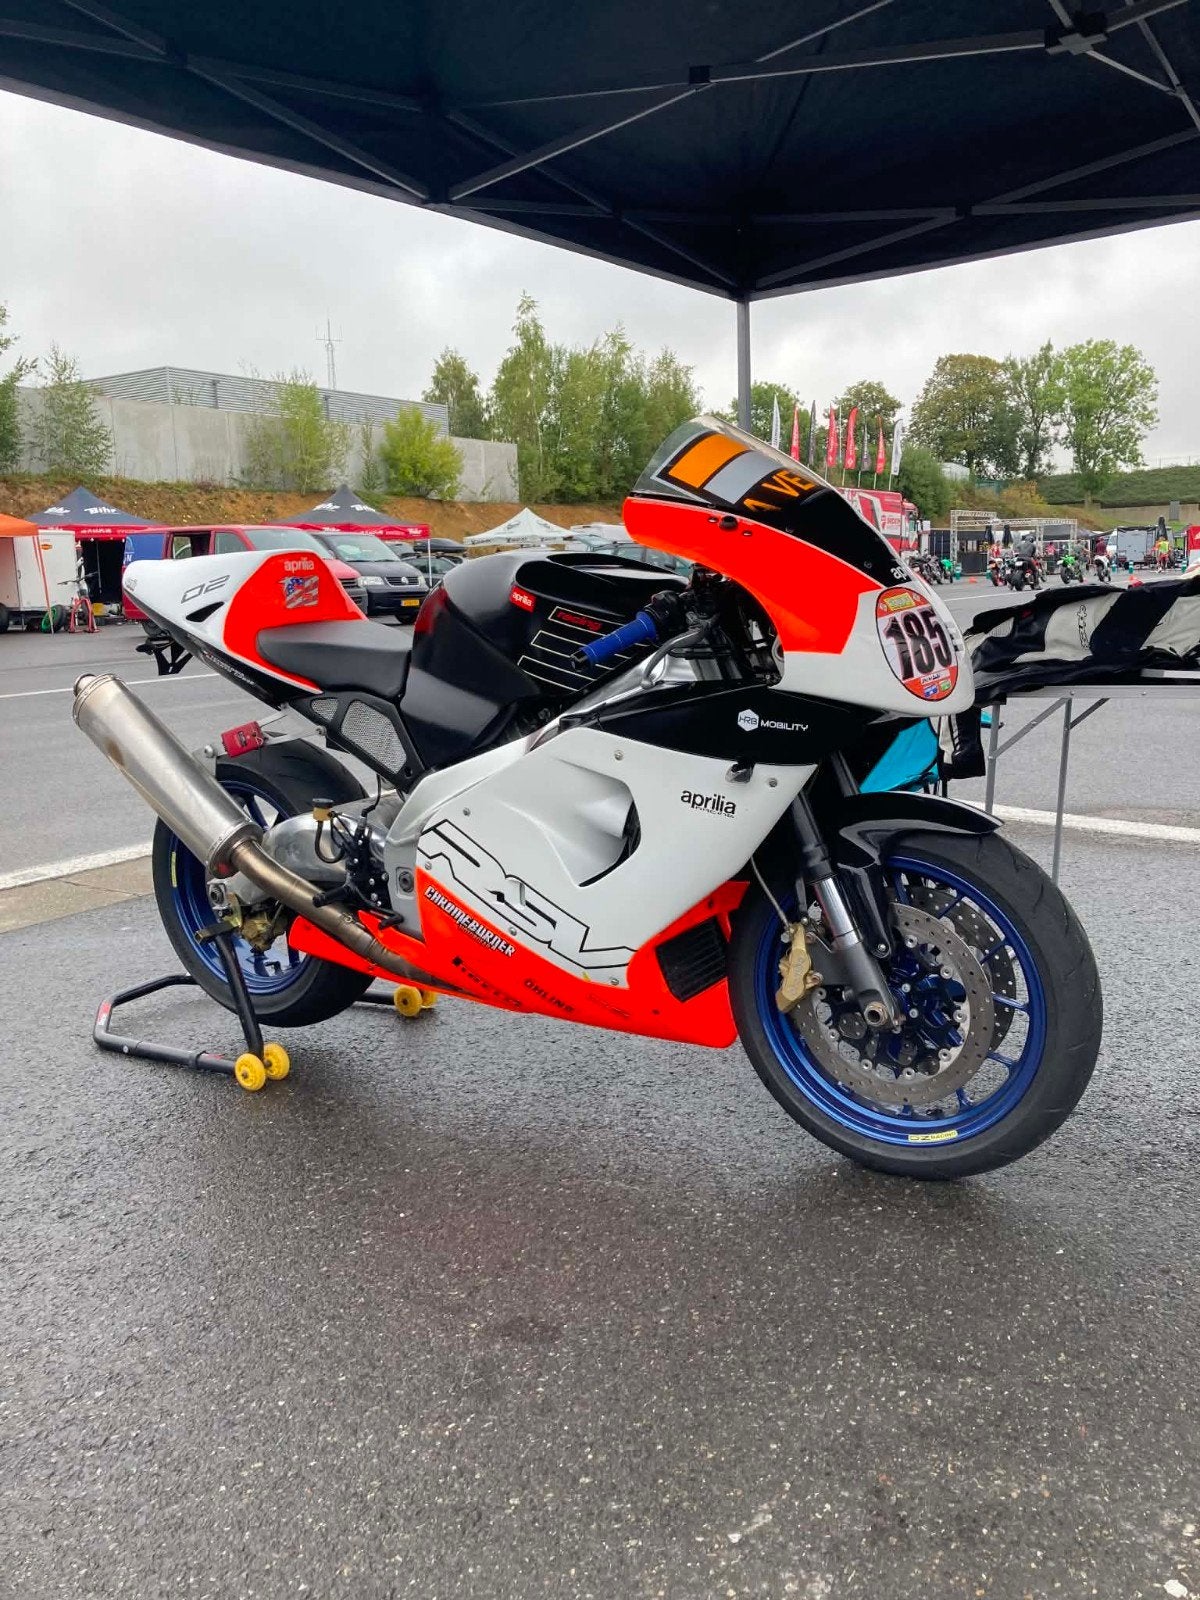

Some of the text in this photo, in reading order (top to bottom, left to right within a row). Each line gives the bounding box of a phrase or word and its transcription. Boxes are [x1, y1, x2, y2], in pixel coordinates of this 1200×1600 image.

[284, 557, 315, 573] aprilia
[512, 591, 533, 606] aprilia
[883, 607, 953, 681] 185
[760, 719, 809, 732] MOBILITY
[680, 789, 737, 815] aprilia
[423, 884, 516, 958] CHROMEBURNER
